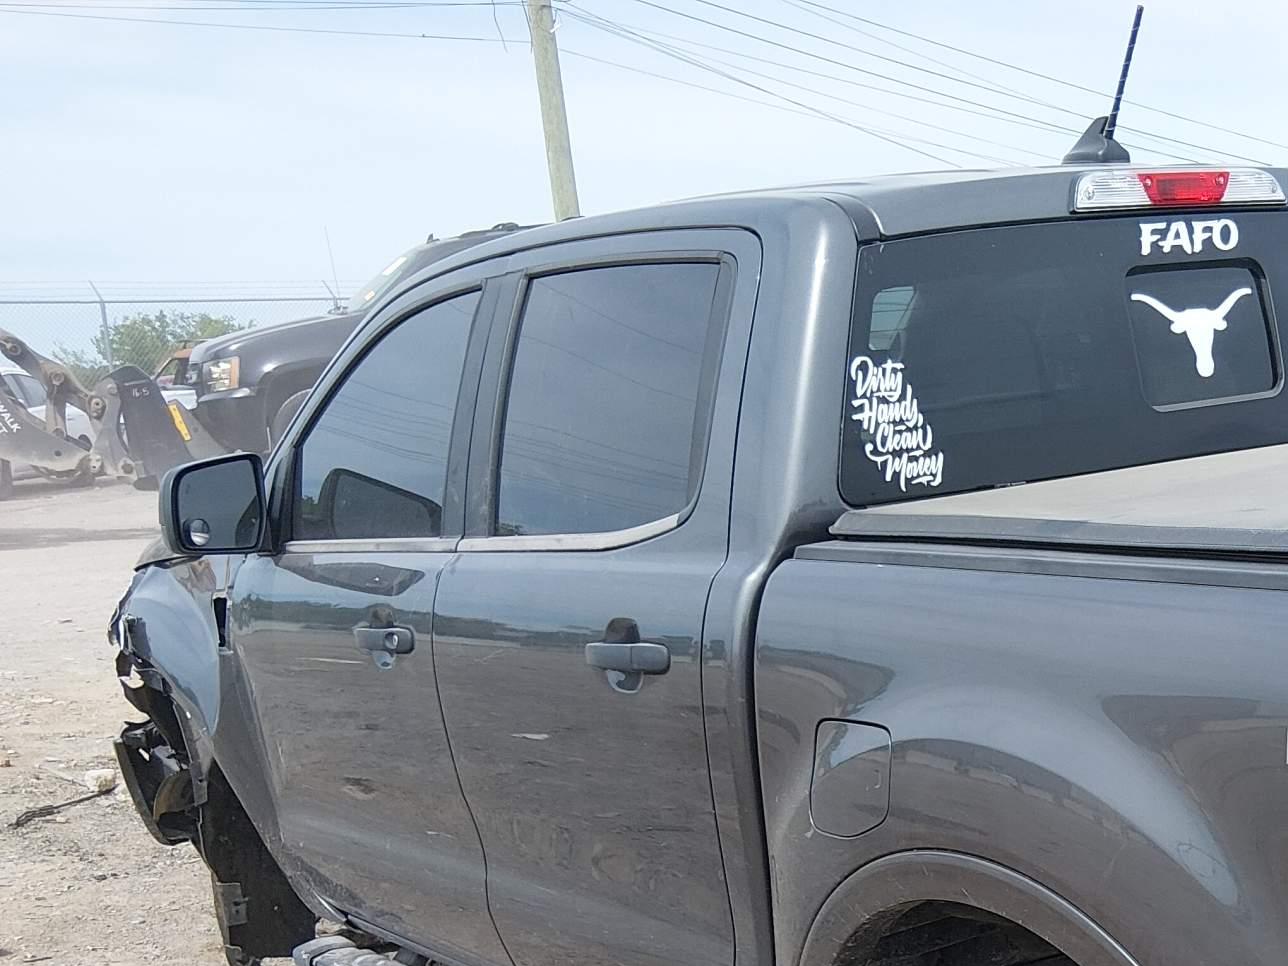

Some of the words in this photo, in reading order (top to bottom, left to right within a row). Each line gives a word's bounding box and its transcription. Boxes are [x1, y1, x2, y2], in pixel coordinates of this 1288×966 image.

[1139, 218, 1239, 256] FAFO
[850, 356, 905, 402] Dirty
[875, 422, 933, 454] Clean
[865, 451, 944, 492] Money
